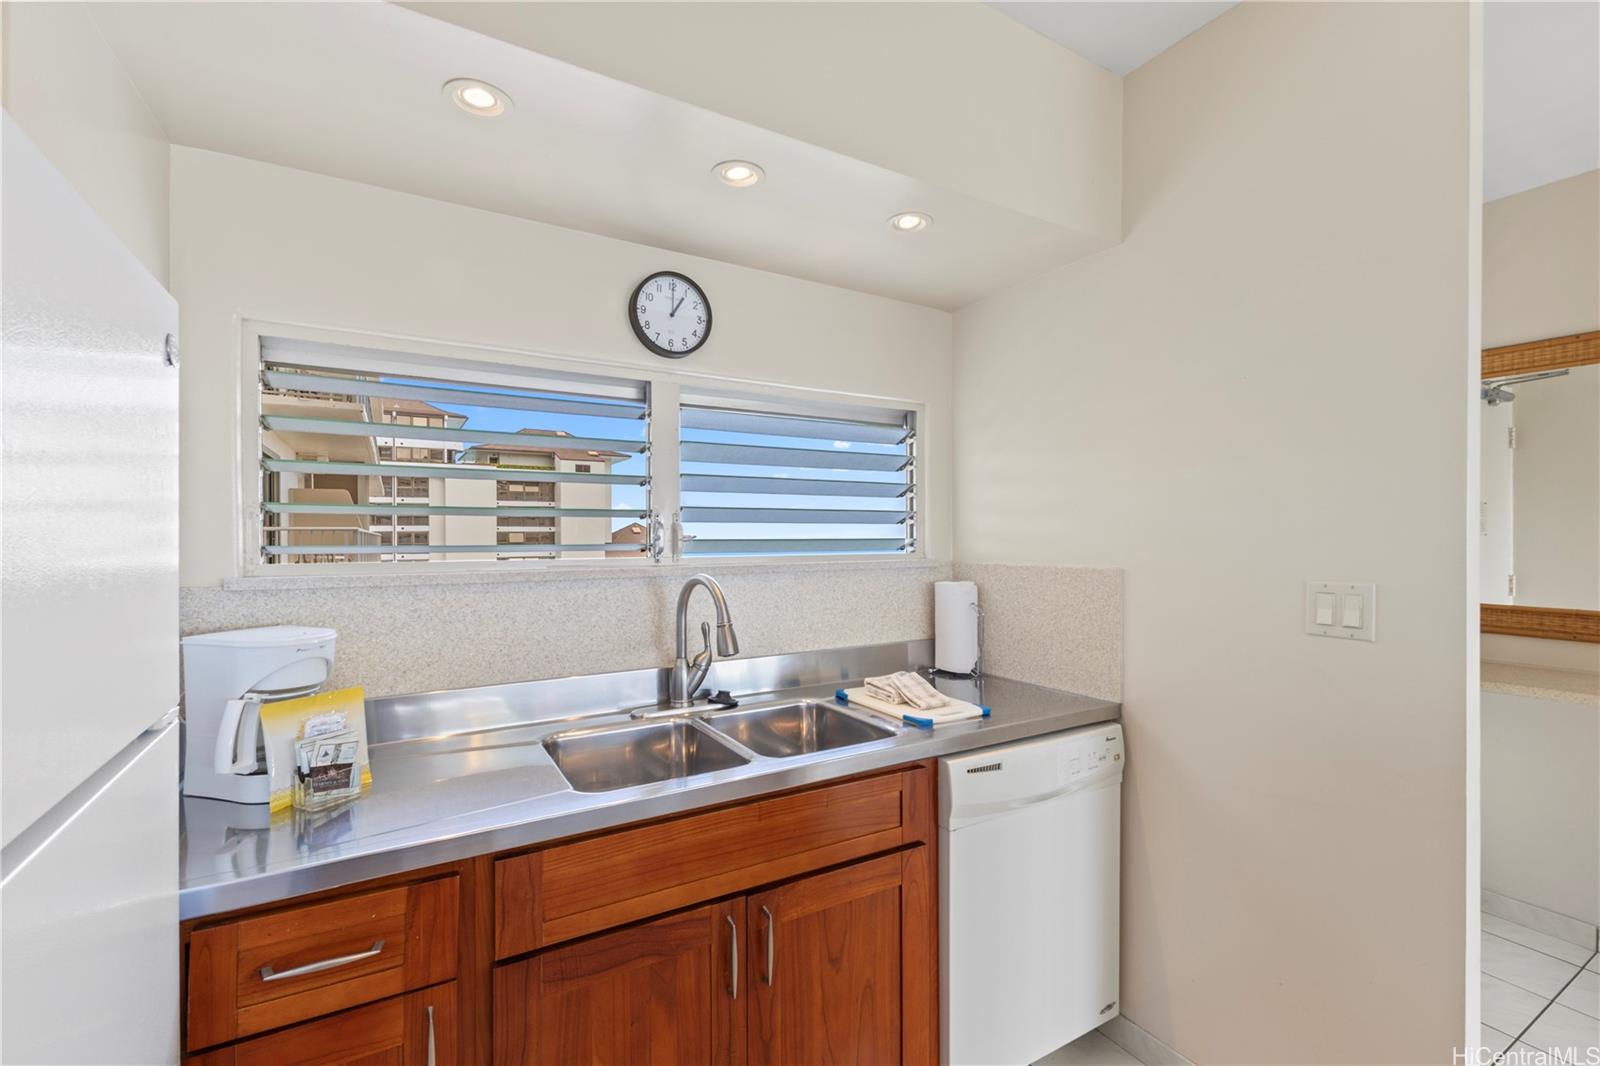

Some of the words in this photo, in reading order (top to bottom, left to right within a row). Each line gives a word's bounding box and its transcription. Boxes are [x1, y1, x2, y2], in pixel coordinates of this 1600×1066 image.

[656, 283, 662, 293] 11
[645, 292, 654, 302] 10
[640, 304, 647, 314] 9
[692, 300, 698, 310] 2
[644, 320, 651, 330] 8
[696, 315, 703, 325] 3
[654, 332, 661, 341] 7
[691, 329, 697, 338] 4
[667, 338, 674, 348] 6
[681, 337, 688, 347] 5
